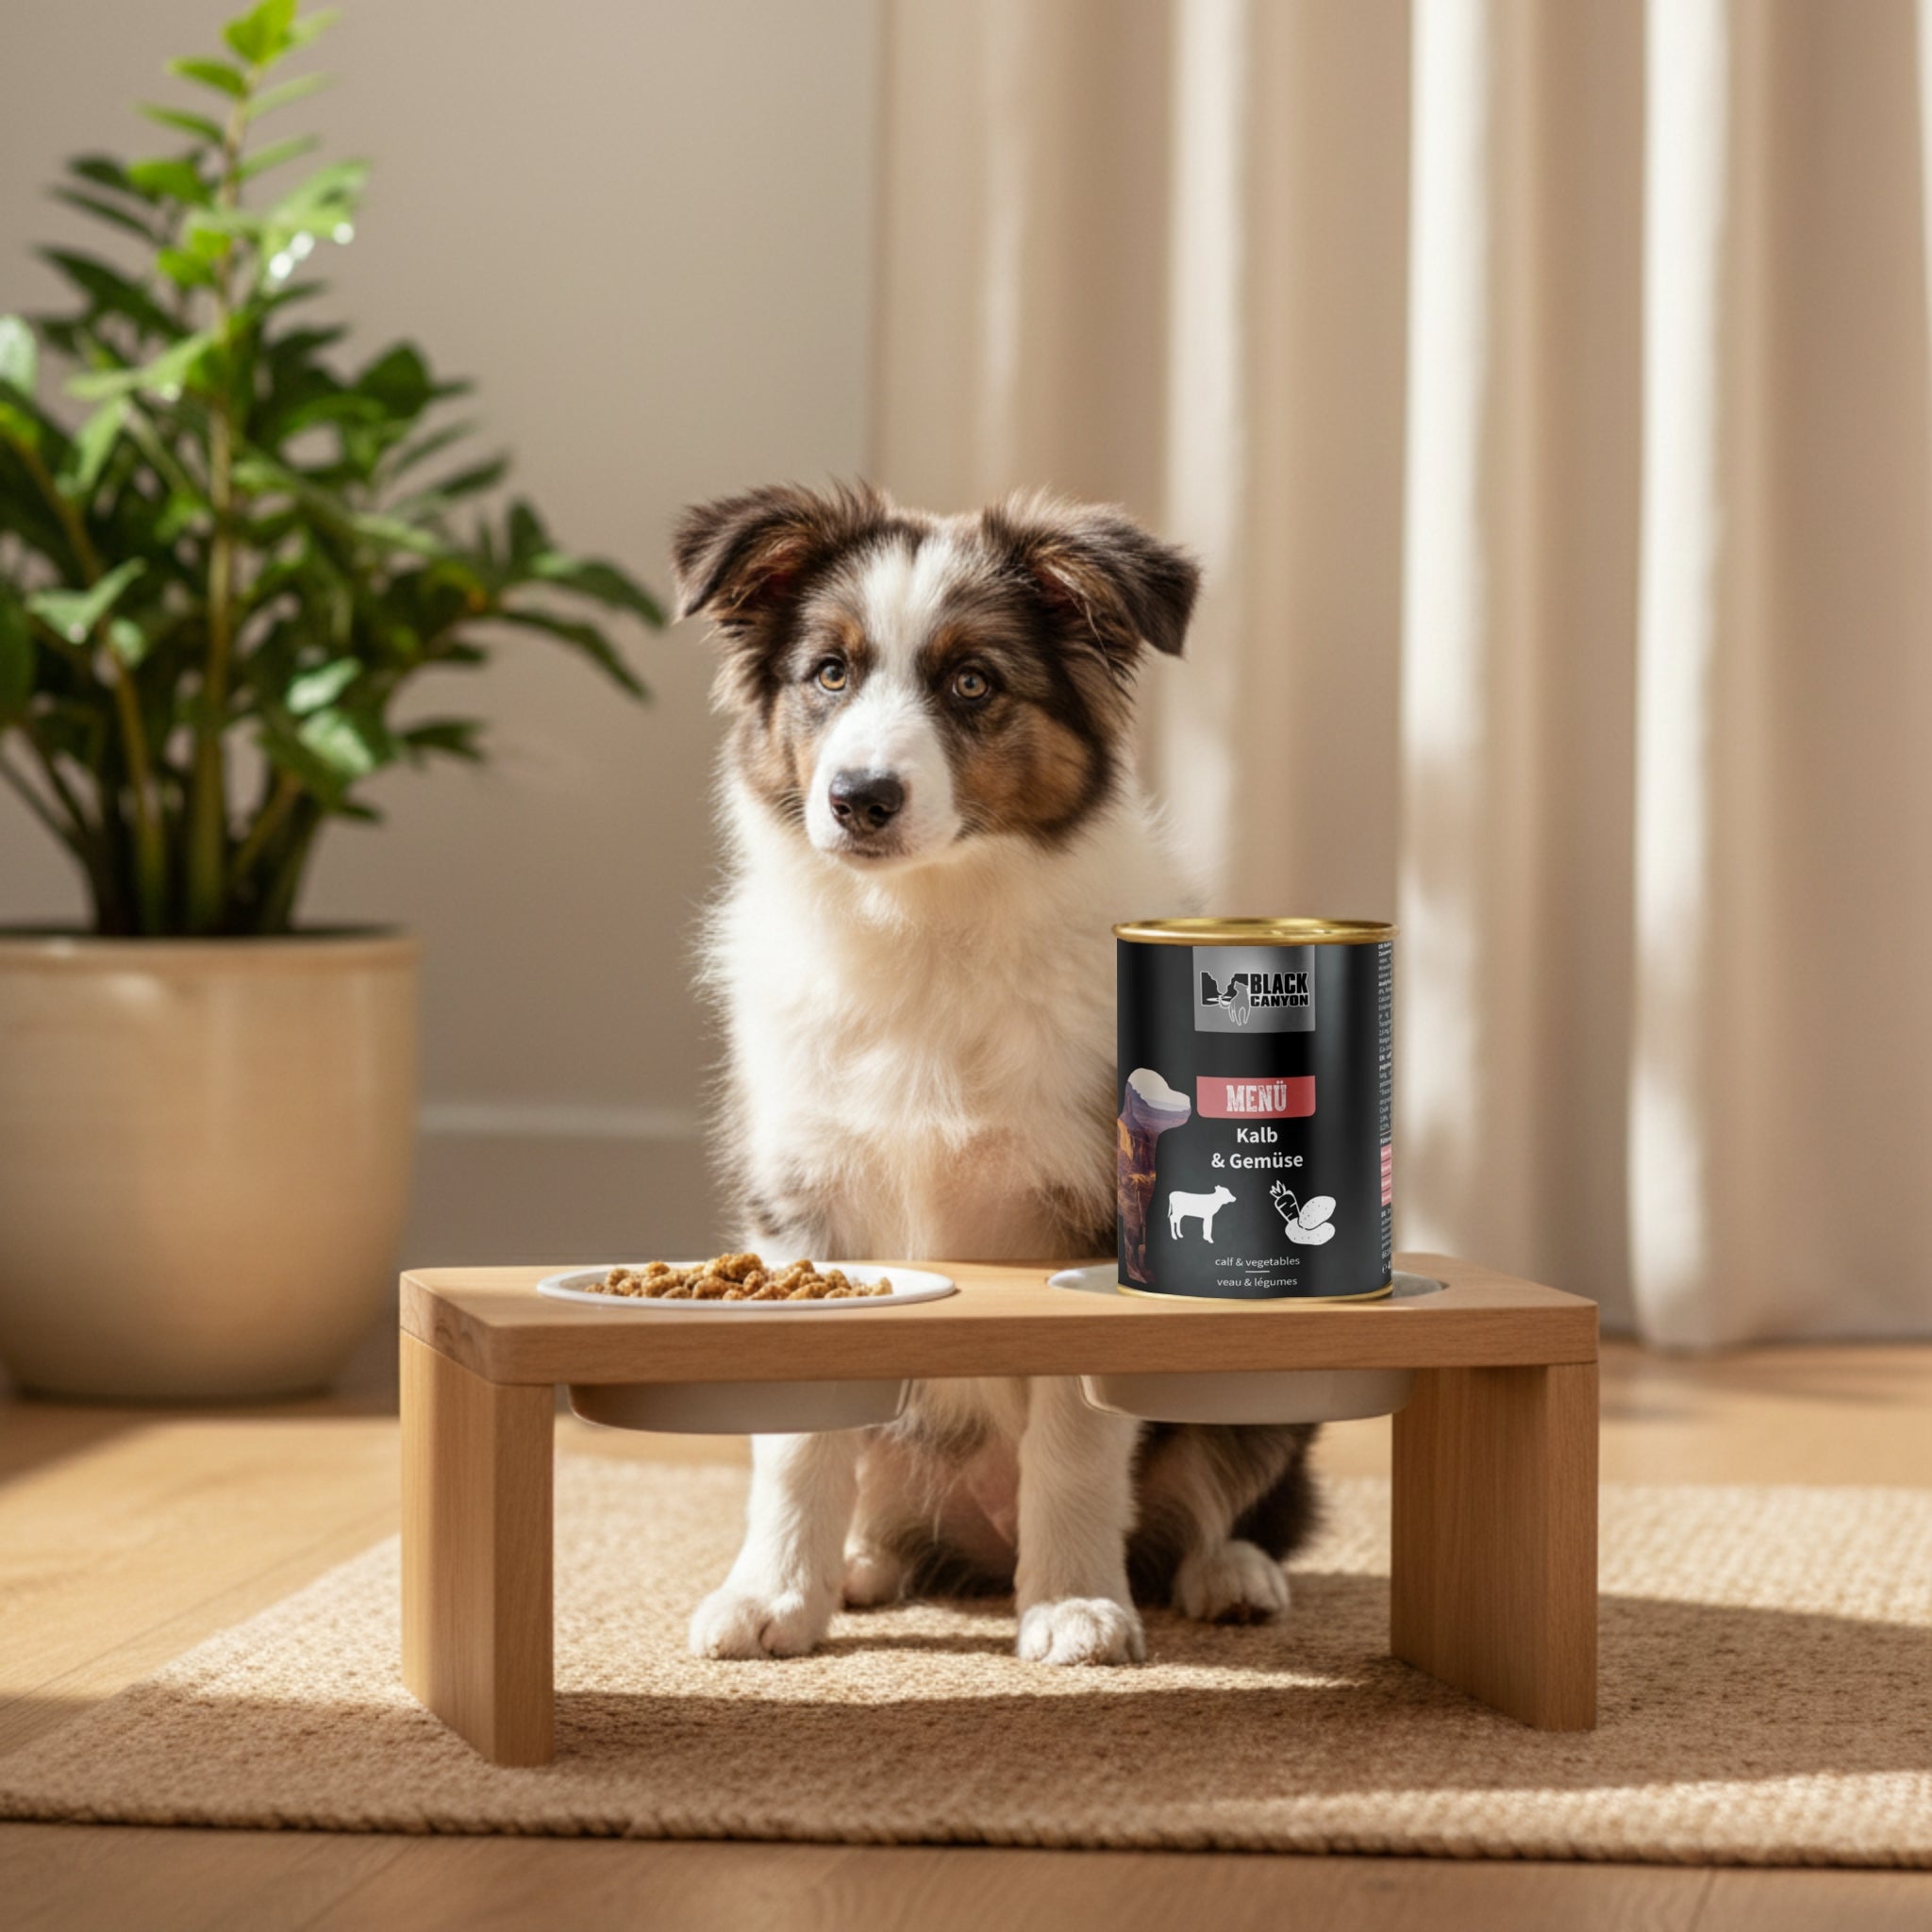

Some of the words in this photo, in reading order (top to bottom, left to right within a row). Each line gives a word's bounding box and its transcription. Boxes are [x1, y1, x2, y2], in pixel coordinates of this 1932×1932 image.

[1250, 973, 1308, 995] BLACK
[1250, 995, 1308, 1007] CANYON
[1225, 1080, 1287, 1112] MENÜ
[1237, 1127, 1278, 1143] Kalb
[1210, 1153, 1225, 1168] &
[1229, 1152, 1304, 1169] Gemüse
[1214, 1257, 1234, 1267] calf
[1235, 1257, 1243, 1267] &
[1244, 1257, 1300, 1269] vegetables
[1216, 1279, 1241, 1288] veau
[1243, 1277, 1253, 1287] &
[1254, 1276, 1298, 1289] légumes
